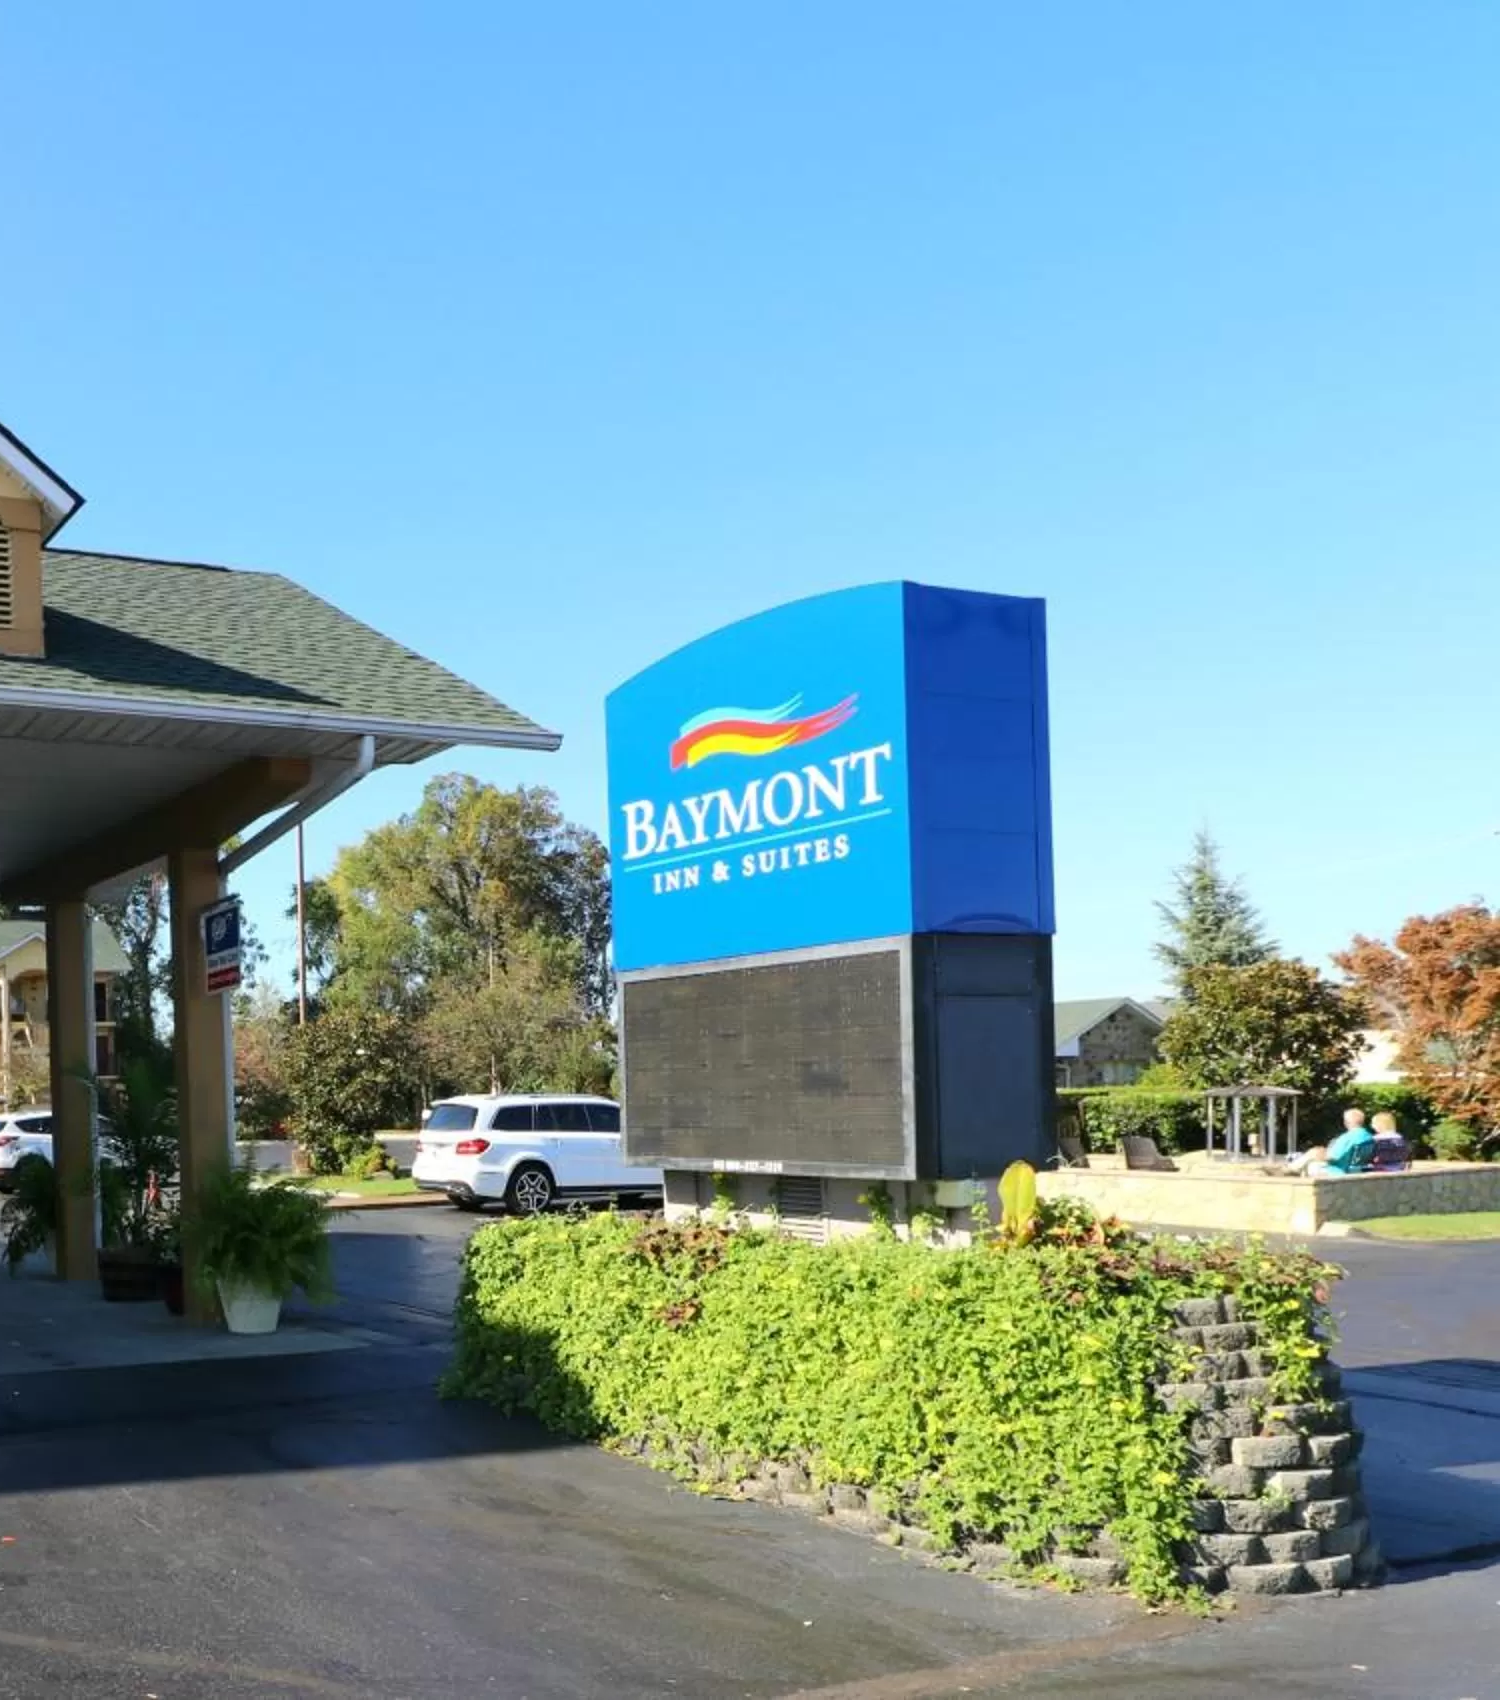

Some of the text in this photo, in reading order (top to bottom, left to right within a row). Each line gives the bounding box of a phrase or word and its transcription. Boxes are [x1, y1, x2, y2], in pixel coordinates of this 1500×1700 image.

[621, 742, 892, 861] BAYMONT
[653, 834, 850, 895] INN & SUITES
